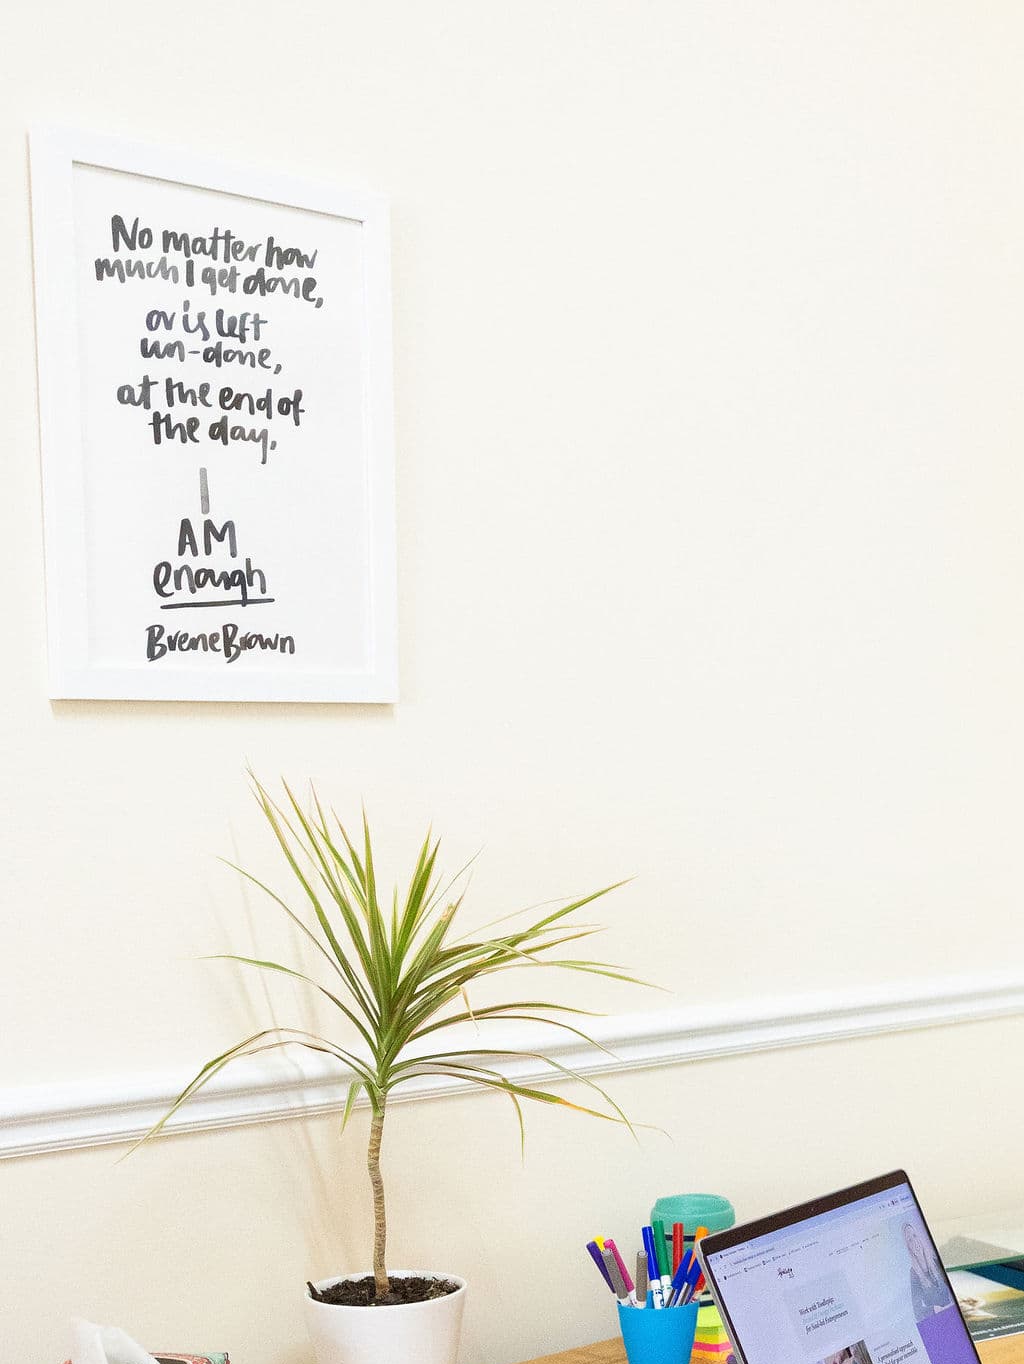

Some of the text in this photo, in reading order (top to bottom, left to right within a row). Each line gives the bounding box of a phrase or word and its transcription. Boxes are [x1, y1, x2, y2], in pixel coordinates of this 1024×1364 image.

[111, 214, 317, 270] No matter how
[95, 256, 323, 308] much I get done,
[146, 299, 268, 343] or is left
[117, 374, 305, 426] at the end of
[148, 411, 277, 464] the day,
[200, 467, 210, 514] I
[177, 518, 237, 558] AM
[153, 558, 267, 607] enough
